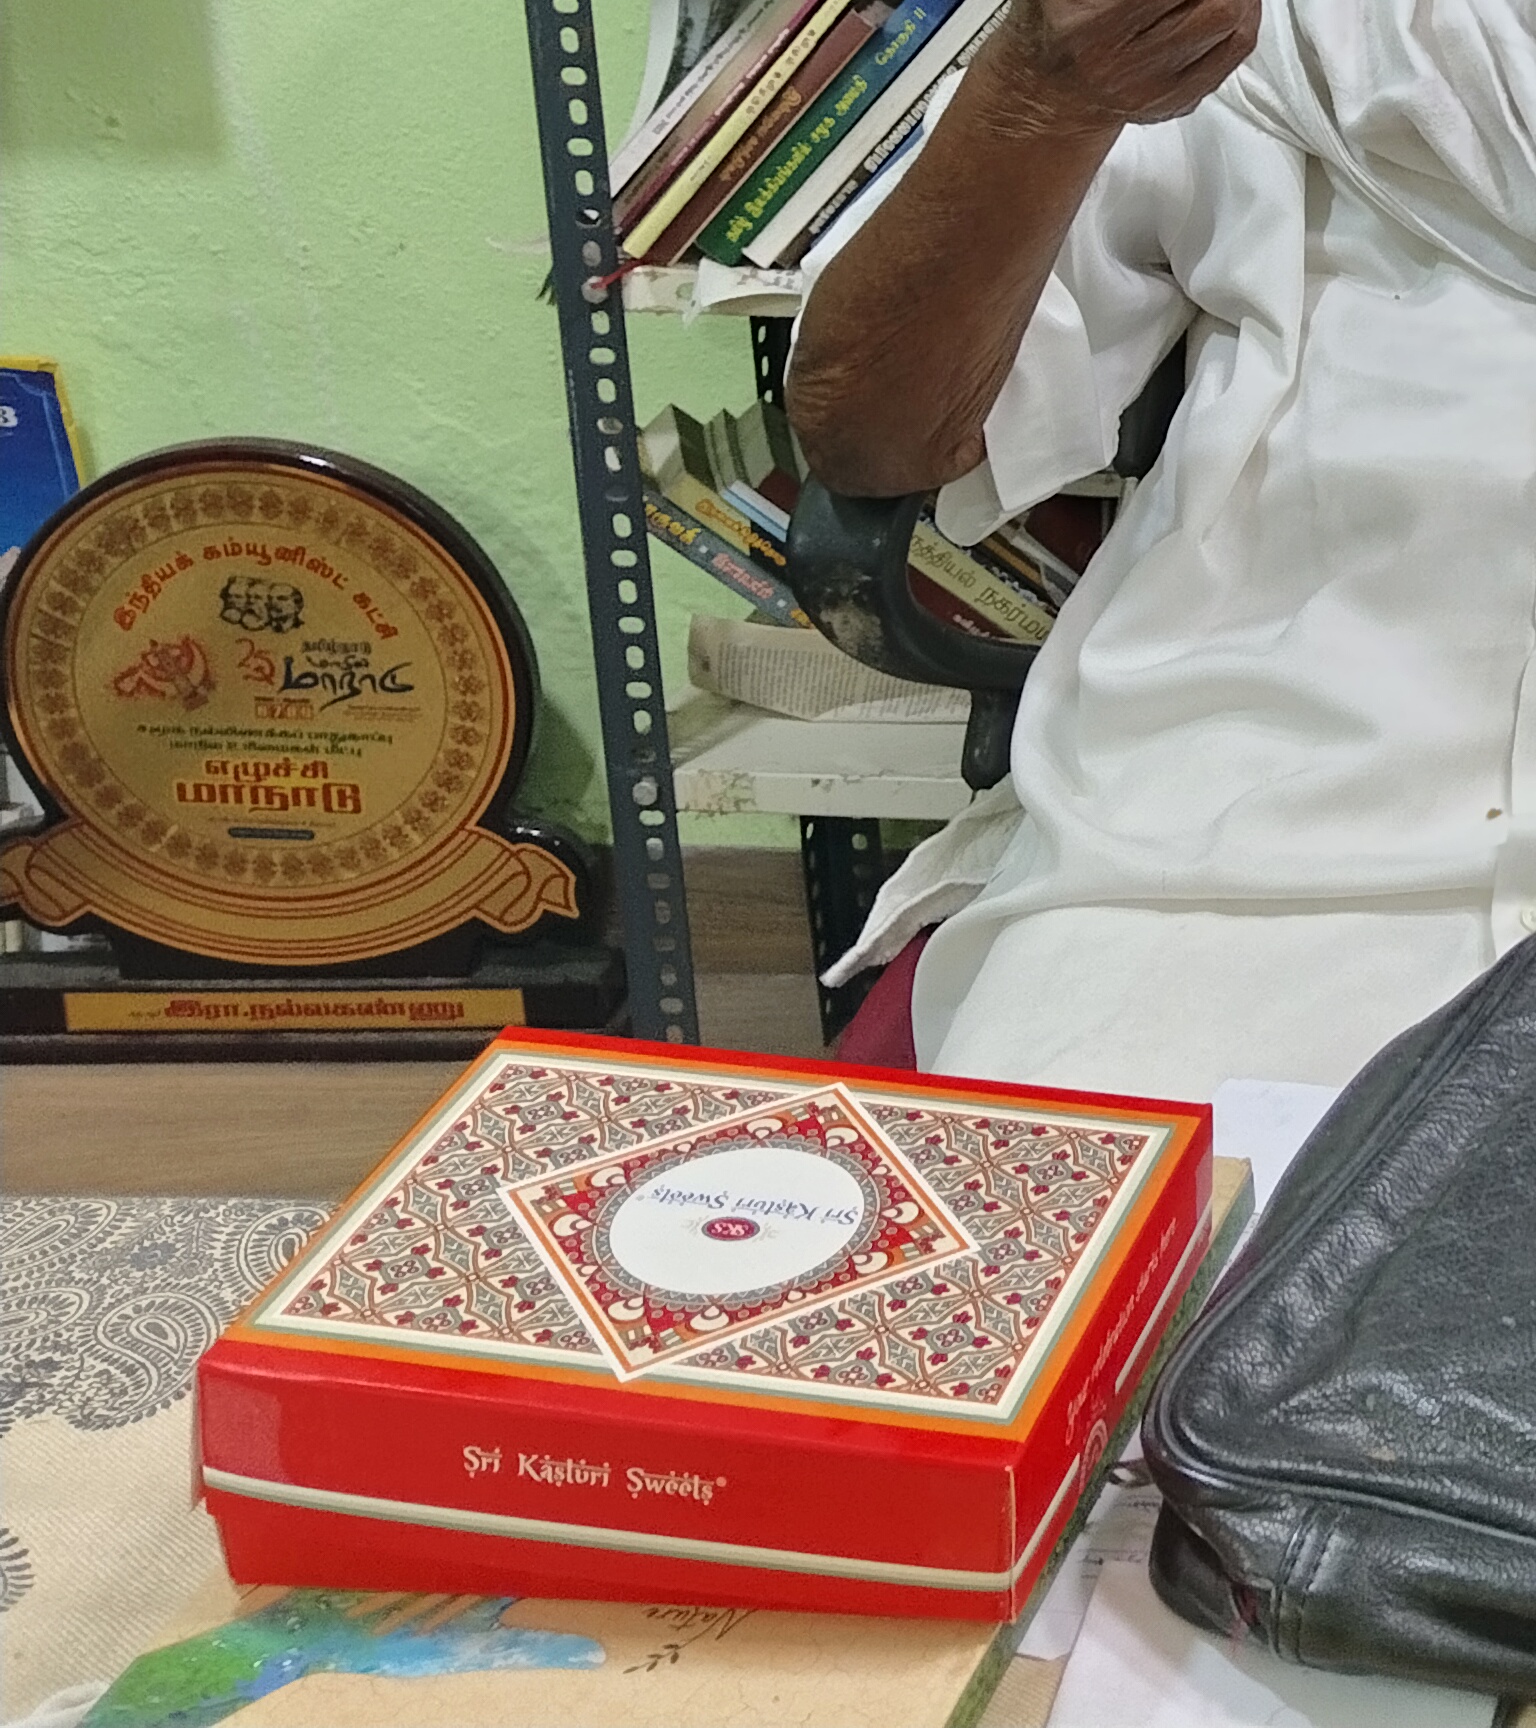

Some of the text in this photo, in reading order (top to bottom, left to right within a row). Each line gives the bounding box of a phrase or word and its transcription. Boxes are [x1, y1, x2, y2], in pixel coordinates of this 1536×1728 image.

[113, 536, 399, 639] இந்தியக் கம்யூனிஸ்ட் கட்சி
[205, 757, 329, 782] எழுச்சி
[176, 781, 362, 814] மாநாடு
[650, 1183, 859, 1226] Sri Kasturi Sweets
[463, 1446, 716, 1506] Sri Kasturi Sweets
[646, 1607, 757, 1641] Nature
